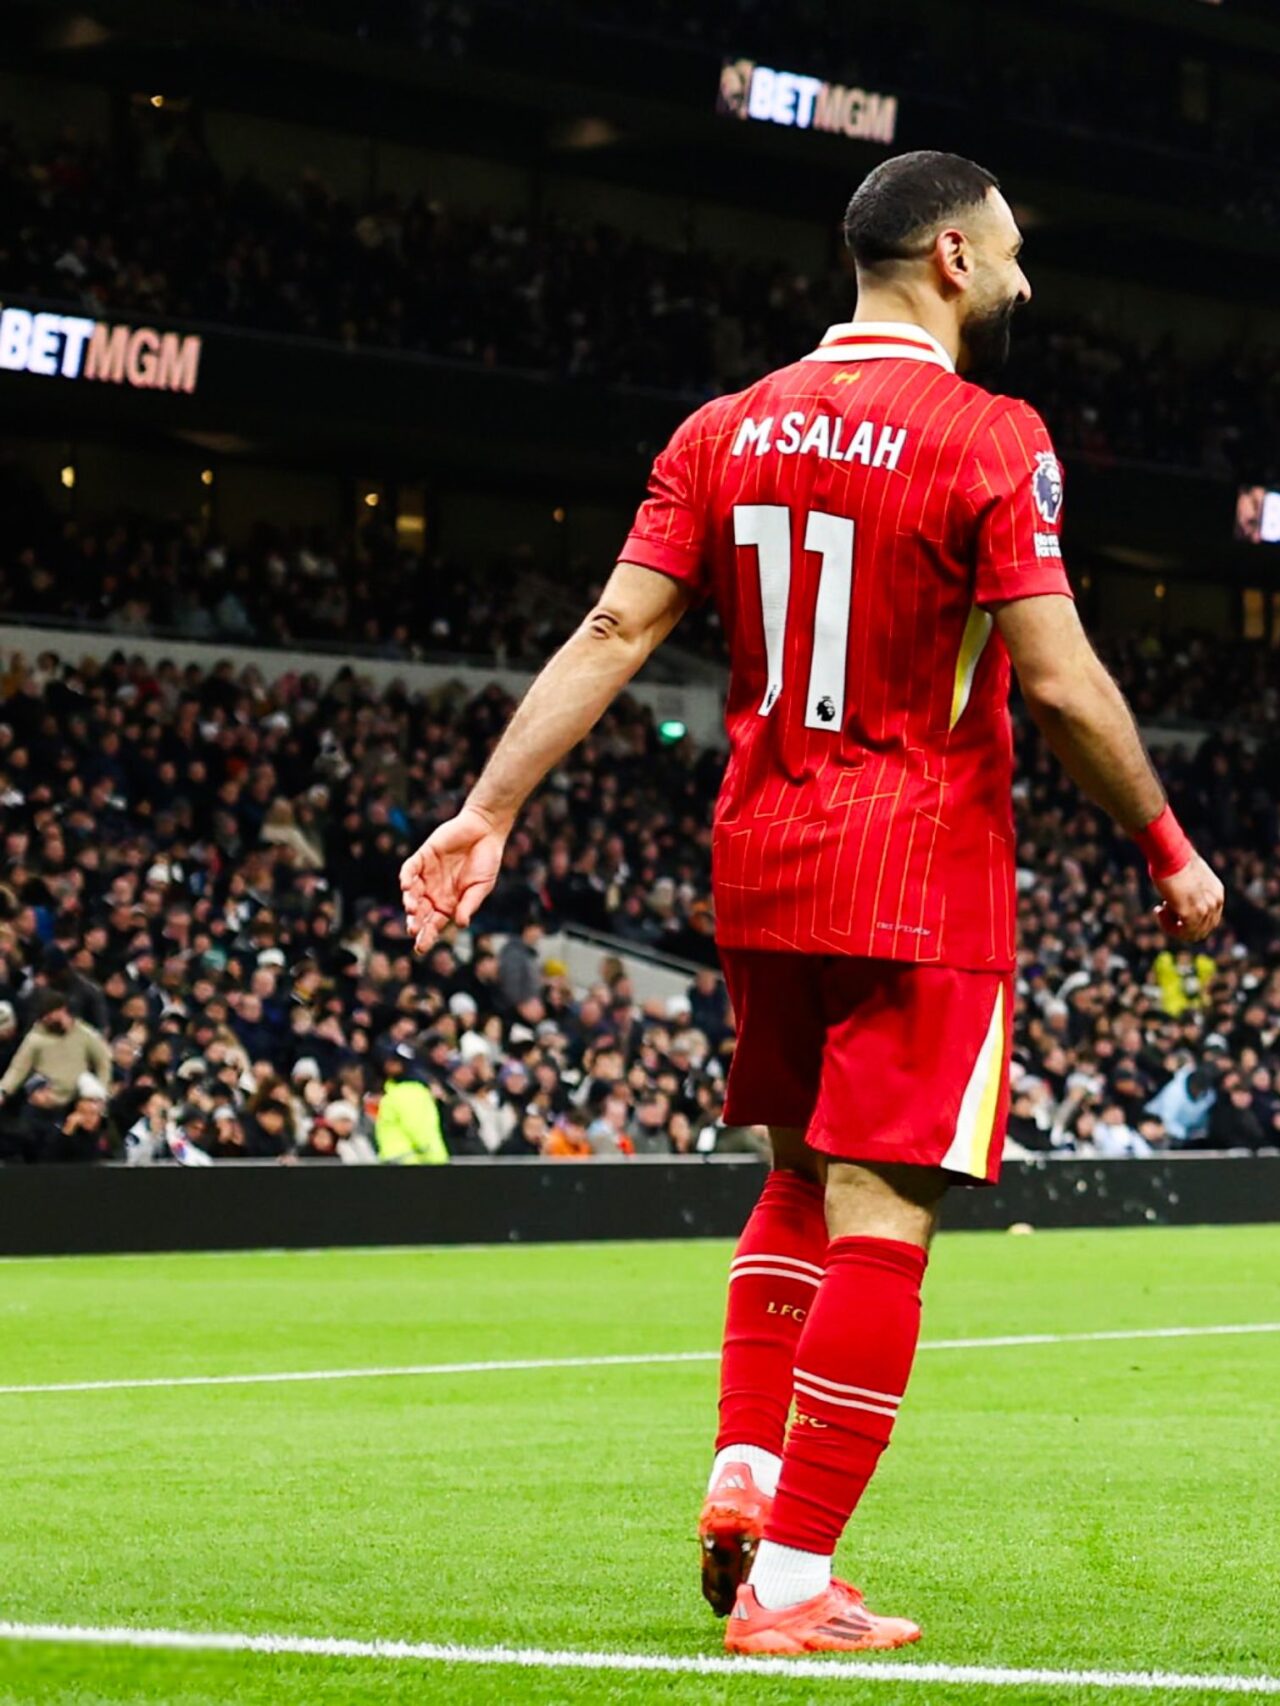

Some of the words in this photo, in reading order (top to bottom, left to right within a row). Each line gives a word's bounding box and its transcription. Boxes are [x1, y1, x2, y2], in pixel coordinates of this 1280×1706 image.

[749, 66, 898, 145] BETMGM
[0, 307, 201, 394] BETMGM
[732, 504, 855, 733] 11
[766, 1301, 807, 1323] LFC
